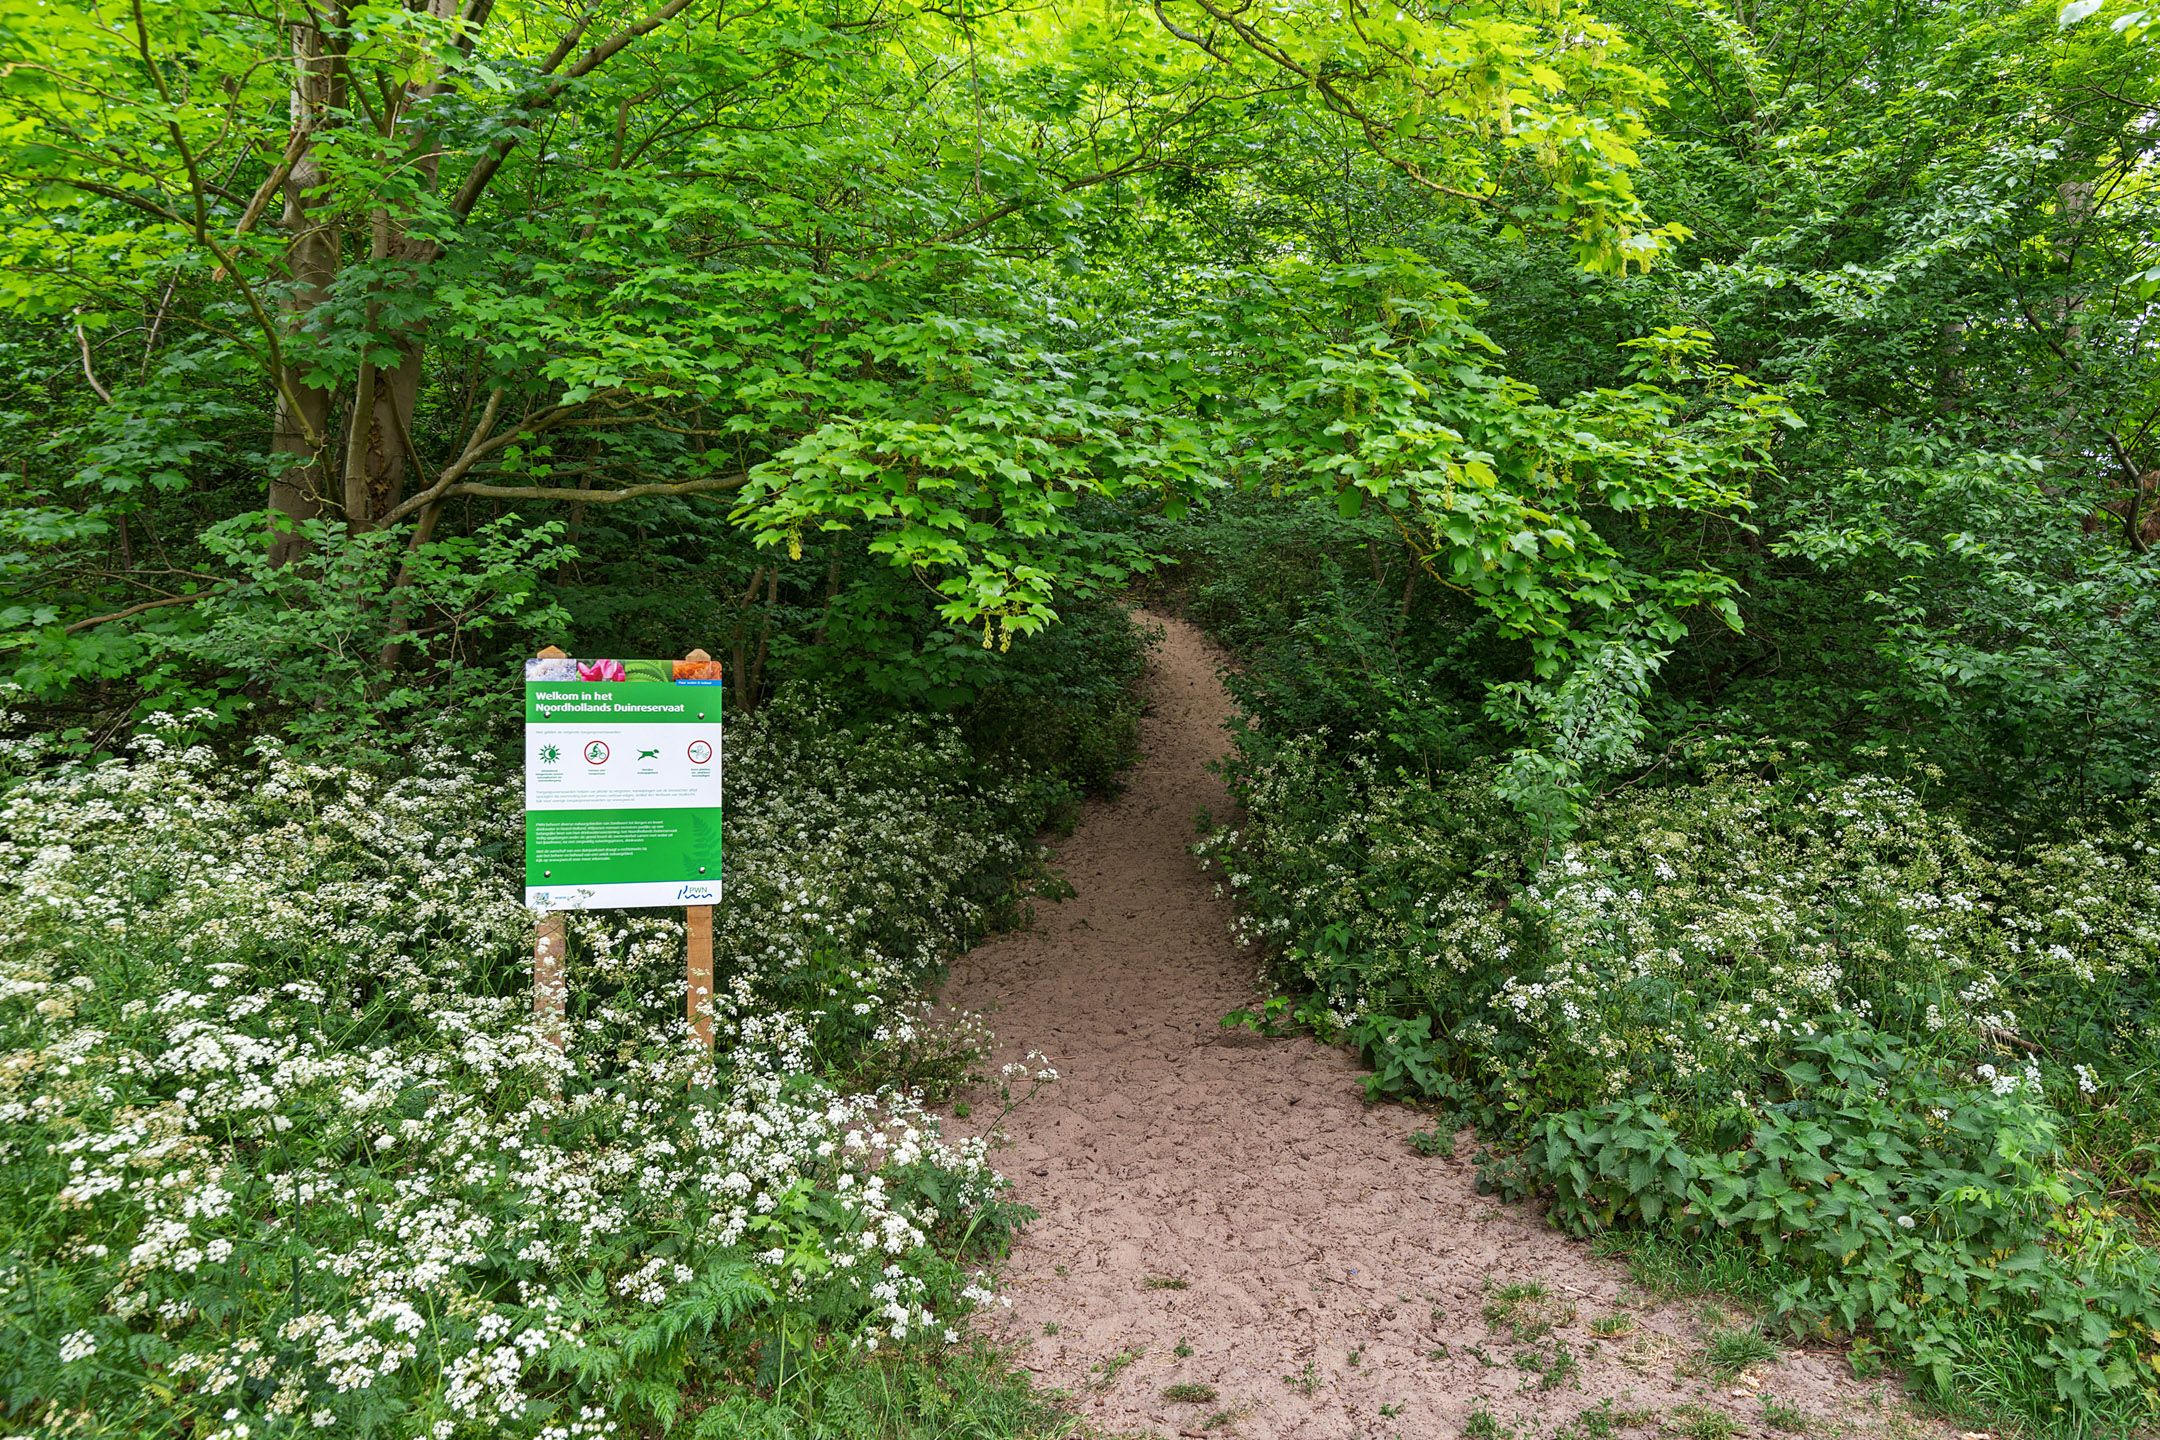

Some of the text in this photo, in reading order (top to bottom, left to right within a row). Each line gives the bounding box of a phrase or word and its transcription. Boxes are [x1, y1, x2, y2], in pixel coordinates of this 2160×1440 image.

[536, 692, 613, 701] Welkom in het
[536, 703, 685, 712] Noordhollands Duinreservaat
[689, 886, 708, 894] PWN
